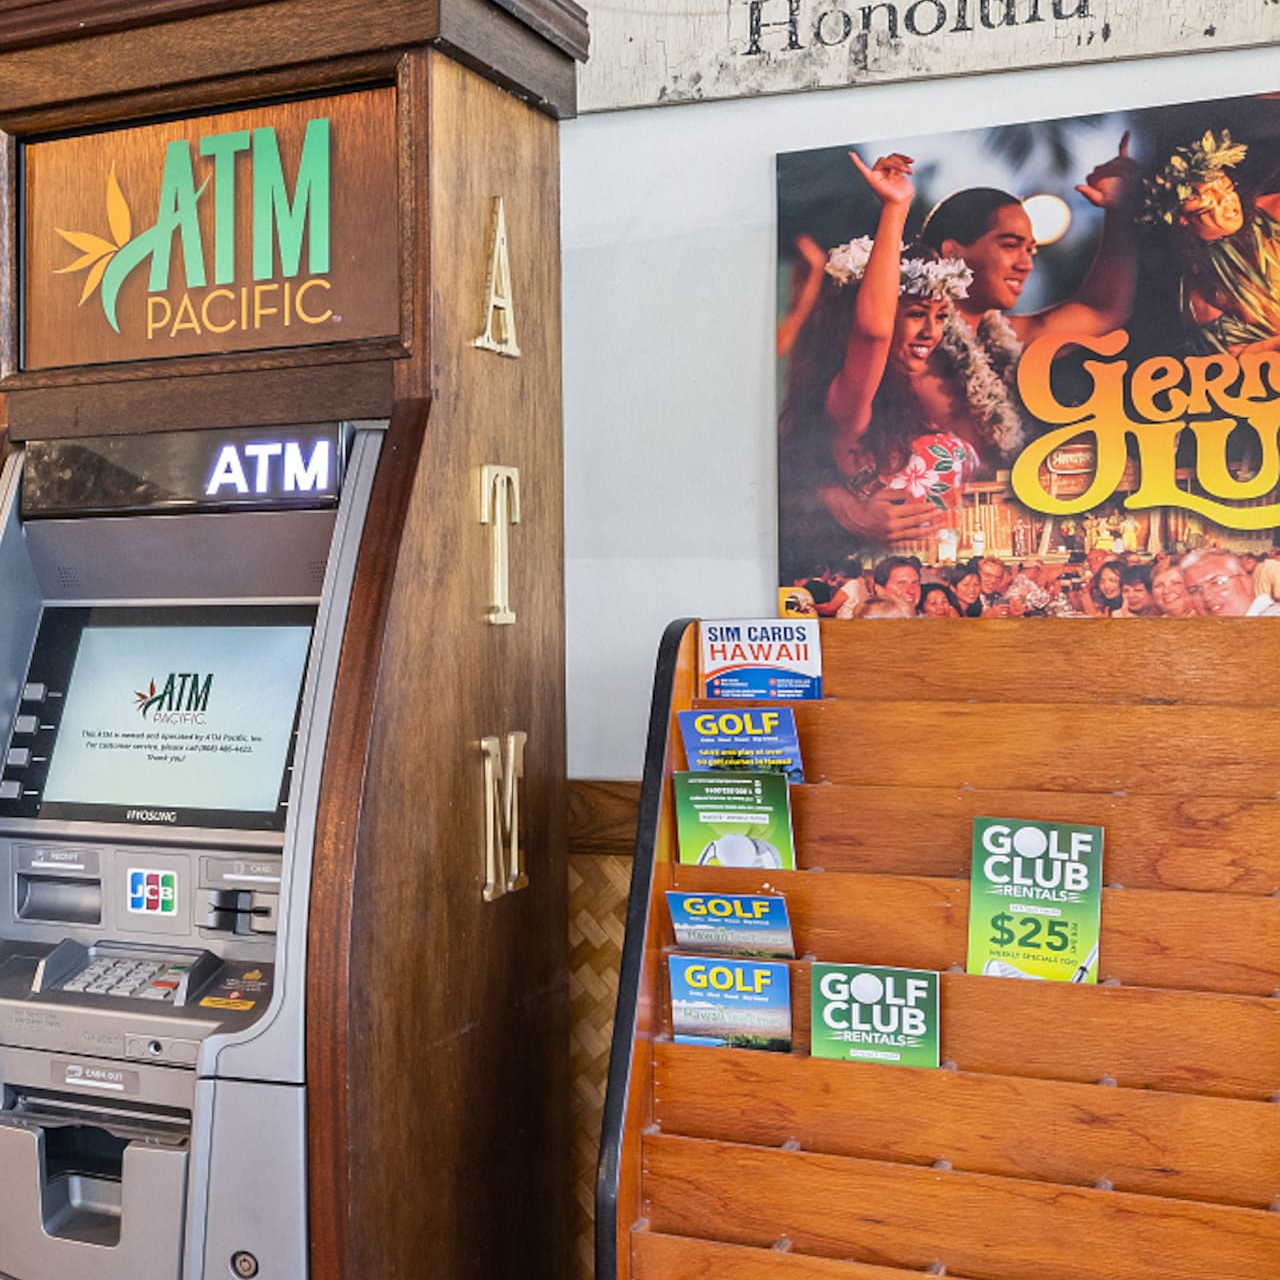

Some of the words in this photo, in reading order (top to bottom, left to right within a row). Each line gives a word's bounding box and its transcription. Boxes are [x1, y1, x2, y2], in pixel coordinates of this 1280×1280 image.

[148, 117, 329, 292] ATM
[147, 279, 332, 339] PACIFIC
[205, 439, 330, 496] ATM
[708, 626, 741, 642] SIM
[748, 626, 807, 642] CARDS
[709, 643, 809, 661] HAWAII
[158, 673, 214, 711] ATM
[694, 712, 780, 736] GOLF
[126, 810, 178, 822] HYOSUNG
[982, 825, 1094, 861] GOLF
[983, 855, 1090, 892] CLUB
[683, 898, 770, 919] GOLF
[1004, 885, 1068, 902] RENTALS
[989, 911, 1070, 952] $25
[684, 965, 772, 994] GOLF
[820, 972, 929, 1006] GOLF
[823, 1001, 927, 1036] CLUB
[844, 1031, 907, 1047] RENTALS
